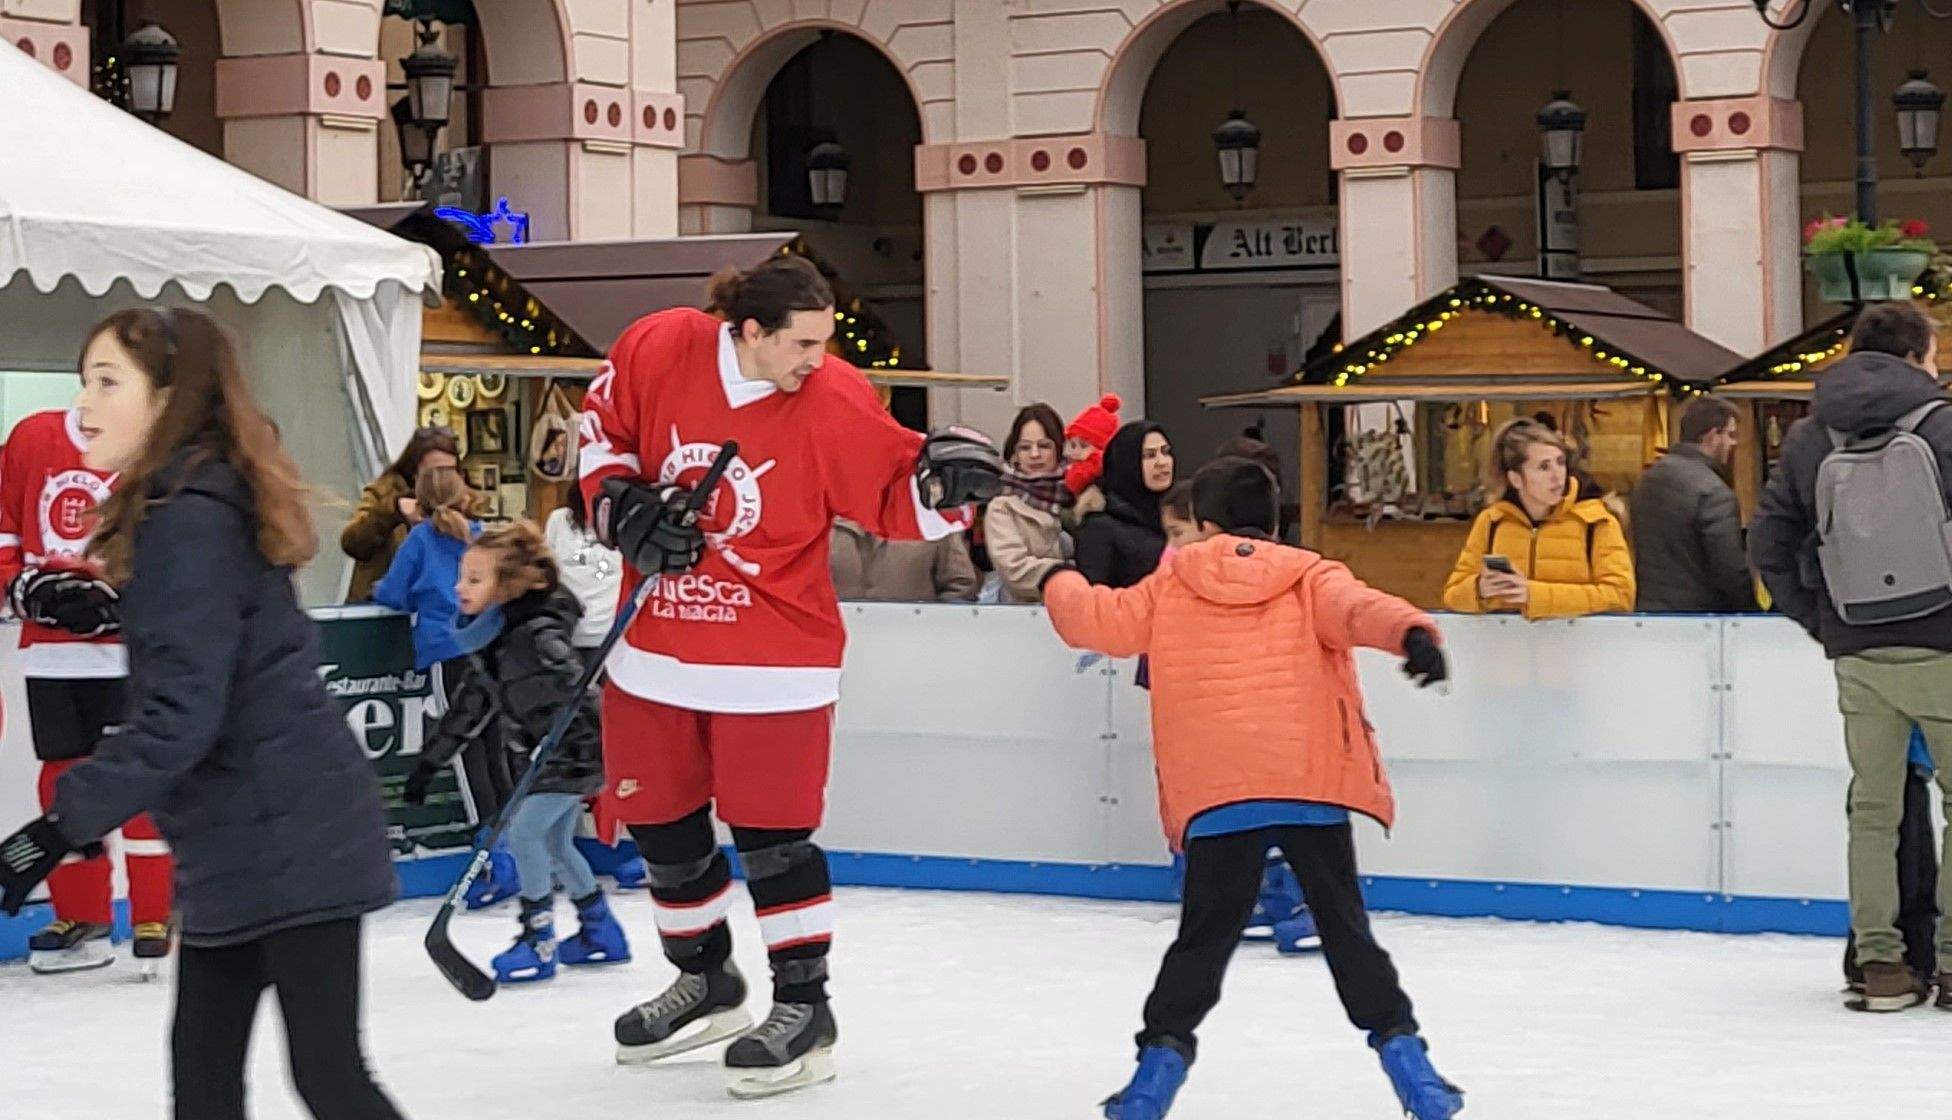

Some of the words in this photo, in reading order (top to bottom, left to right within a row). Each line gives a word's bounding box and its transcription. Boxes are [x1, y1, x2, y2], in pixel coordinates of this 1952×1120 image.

[1230, 228, 1273, 257] Alt
[325, 669, 428, 696] estaurante-Bar
[344, 695, 446, 759] er
